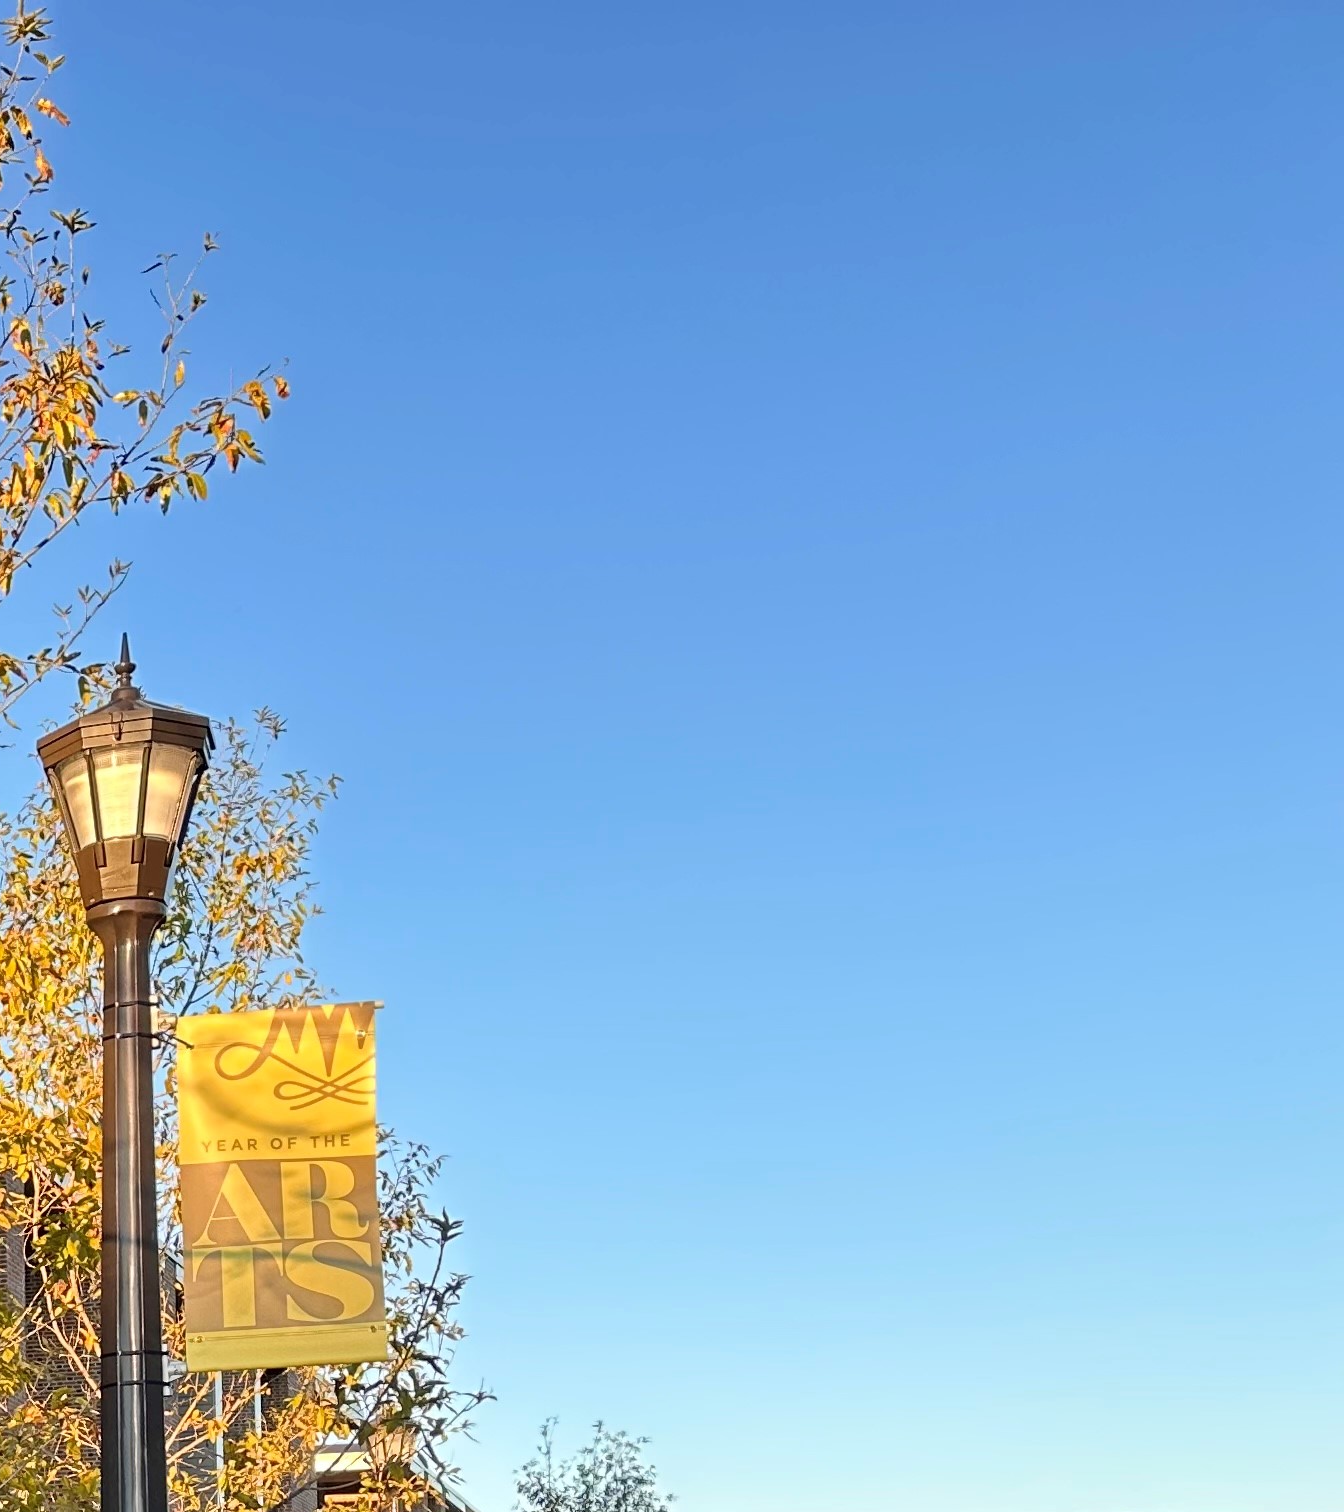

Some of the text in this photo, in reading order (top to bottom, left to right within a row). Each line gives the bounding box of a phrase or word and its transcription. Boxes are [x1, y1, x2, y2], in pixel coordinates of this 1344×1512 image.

[201, 1133, 351, 1153] YEAR OF THE
[191, 1160, 370, 1247] AR
[192, 1239, 375, 1328] TS
